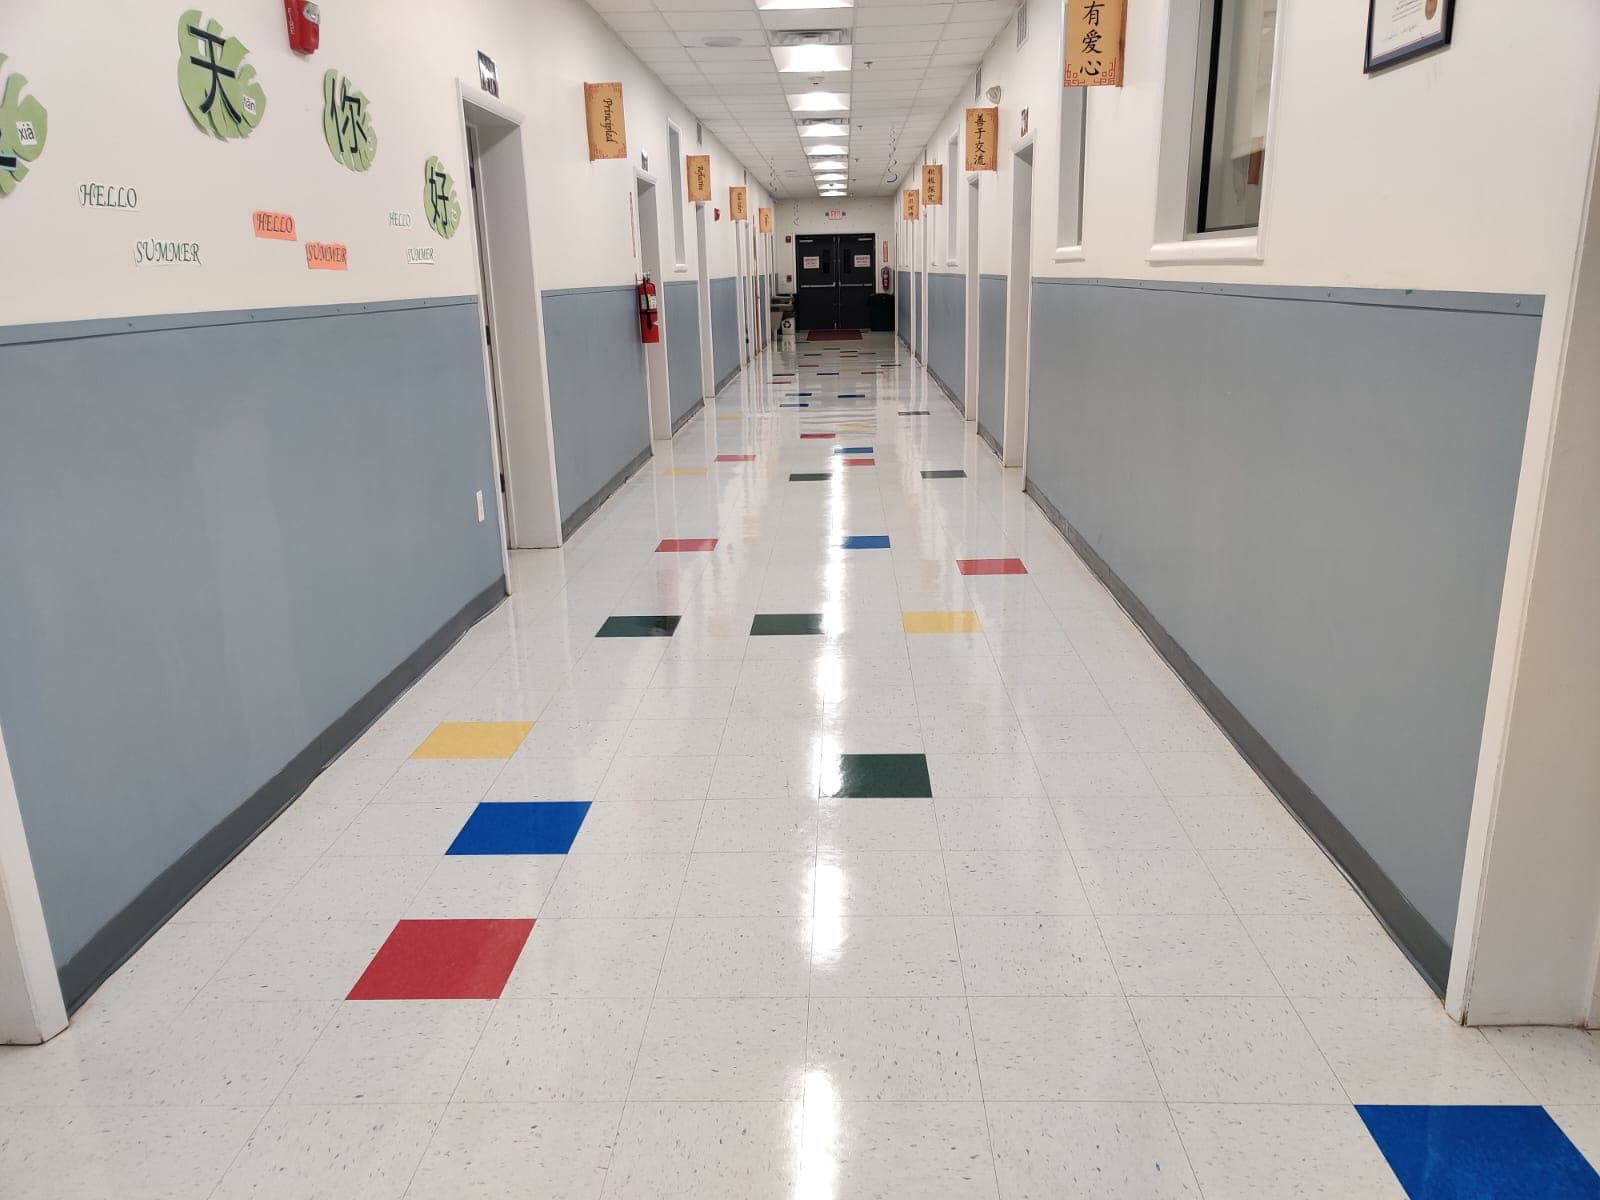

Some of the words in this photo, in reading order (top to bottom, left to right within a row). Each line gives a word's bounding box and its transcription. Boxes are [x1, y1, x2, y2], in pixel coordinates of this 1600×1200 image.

[1080, 1, 1105, 76] 有爱心
[187, 24, 242, 125] 天
[330, 78, 368, 154] 你
[600, 98, 618, 144] Principled
[974, 113, 986, 166] 善于交流
[79, 182, 137, 208] HELLO
[428, 167, 449, 225] 好
[257, 212, 293, 234] HELLO
[388, 211, 411, 227] HELLO
[136, 238, 202, 265] SUMMER
[308, 243, 347, 265] SUMMER
[407, 247, 434, 262] SUMMER
